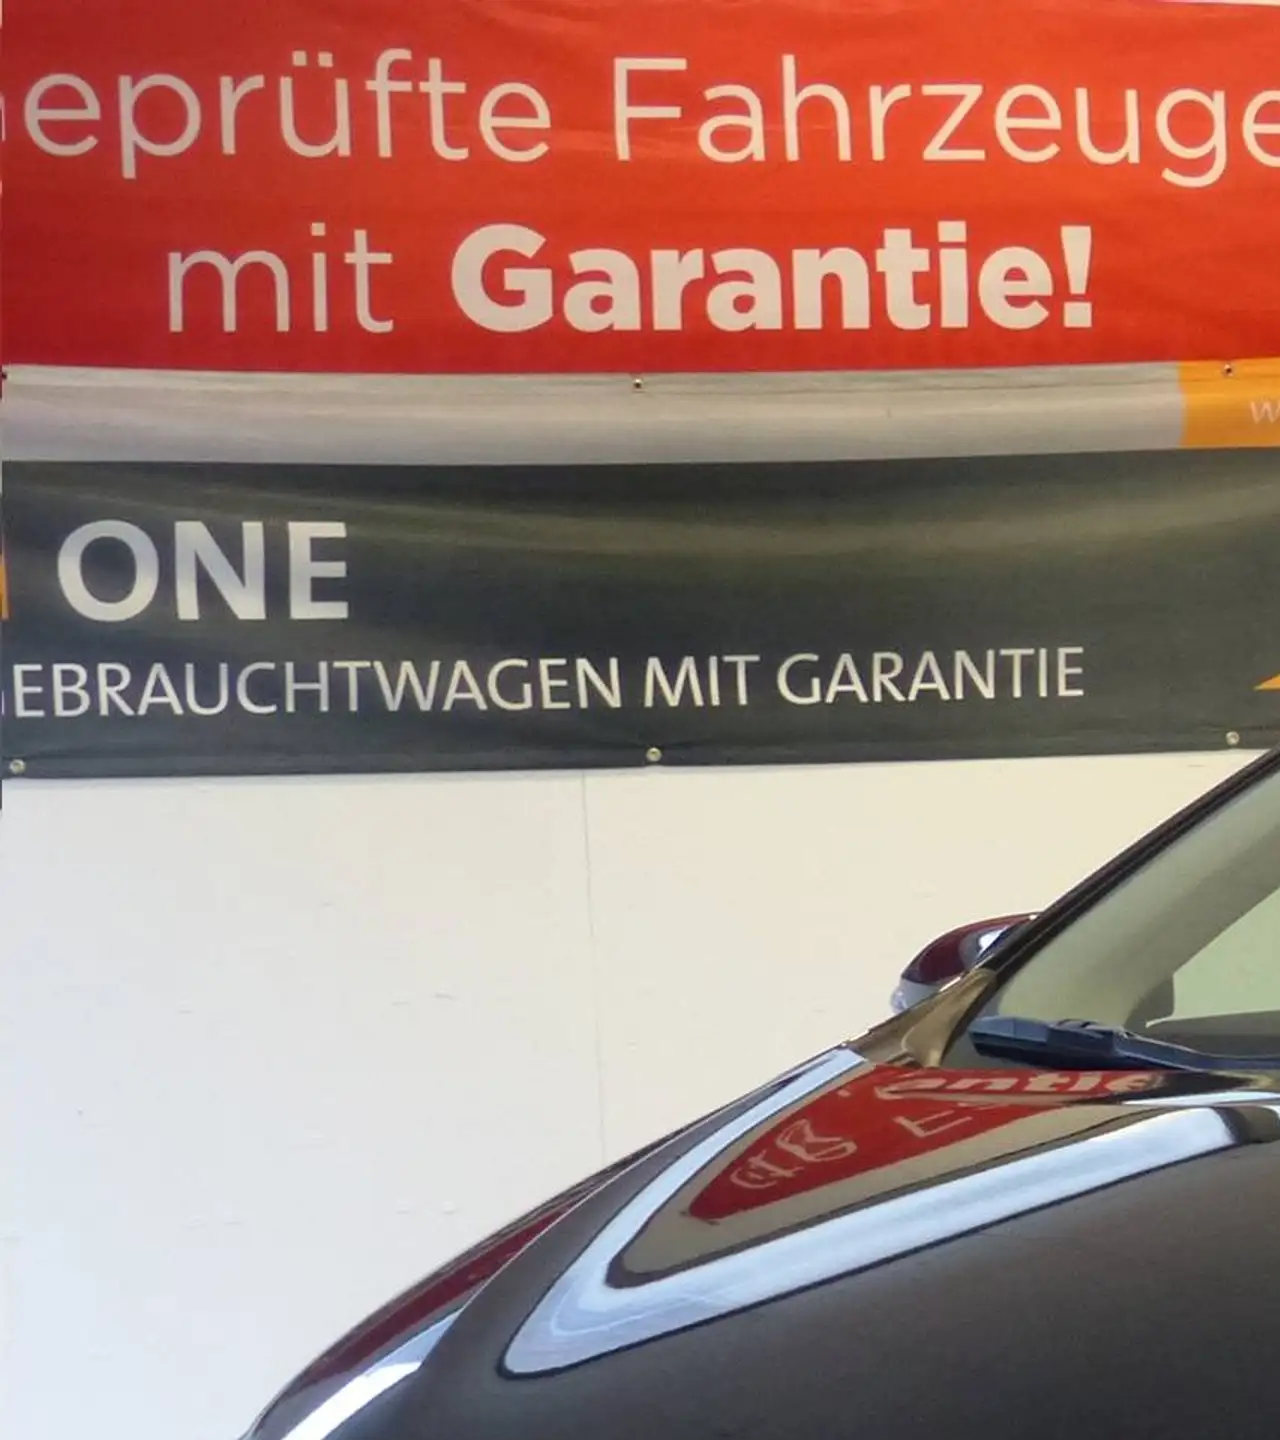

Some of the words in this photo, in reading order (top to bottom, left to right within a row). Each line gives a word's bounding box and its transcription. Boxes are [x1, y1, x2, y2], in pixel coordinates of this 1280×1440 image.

[0, 49, 552, 179] eprüfte
[168, 222, 394, 334] mit
[450, 220, 1094, 333] Garantie!
[57, 519, 349, 623] ONE
[0, 656, 622, 718] EBRAUCHTWAGEN
[644, 654, 762, 708] MIT
[776, 646, 1086, 706] GARANTIE
